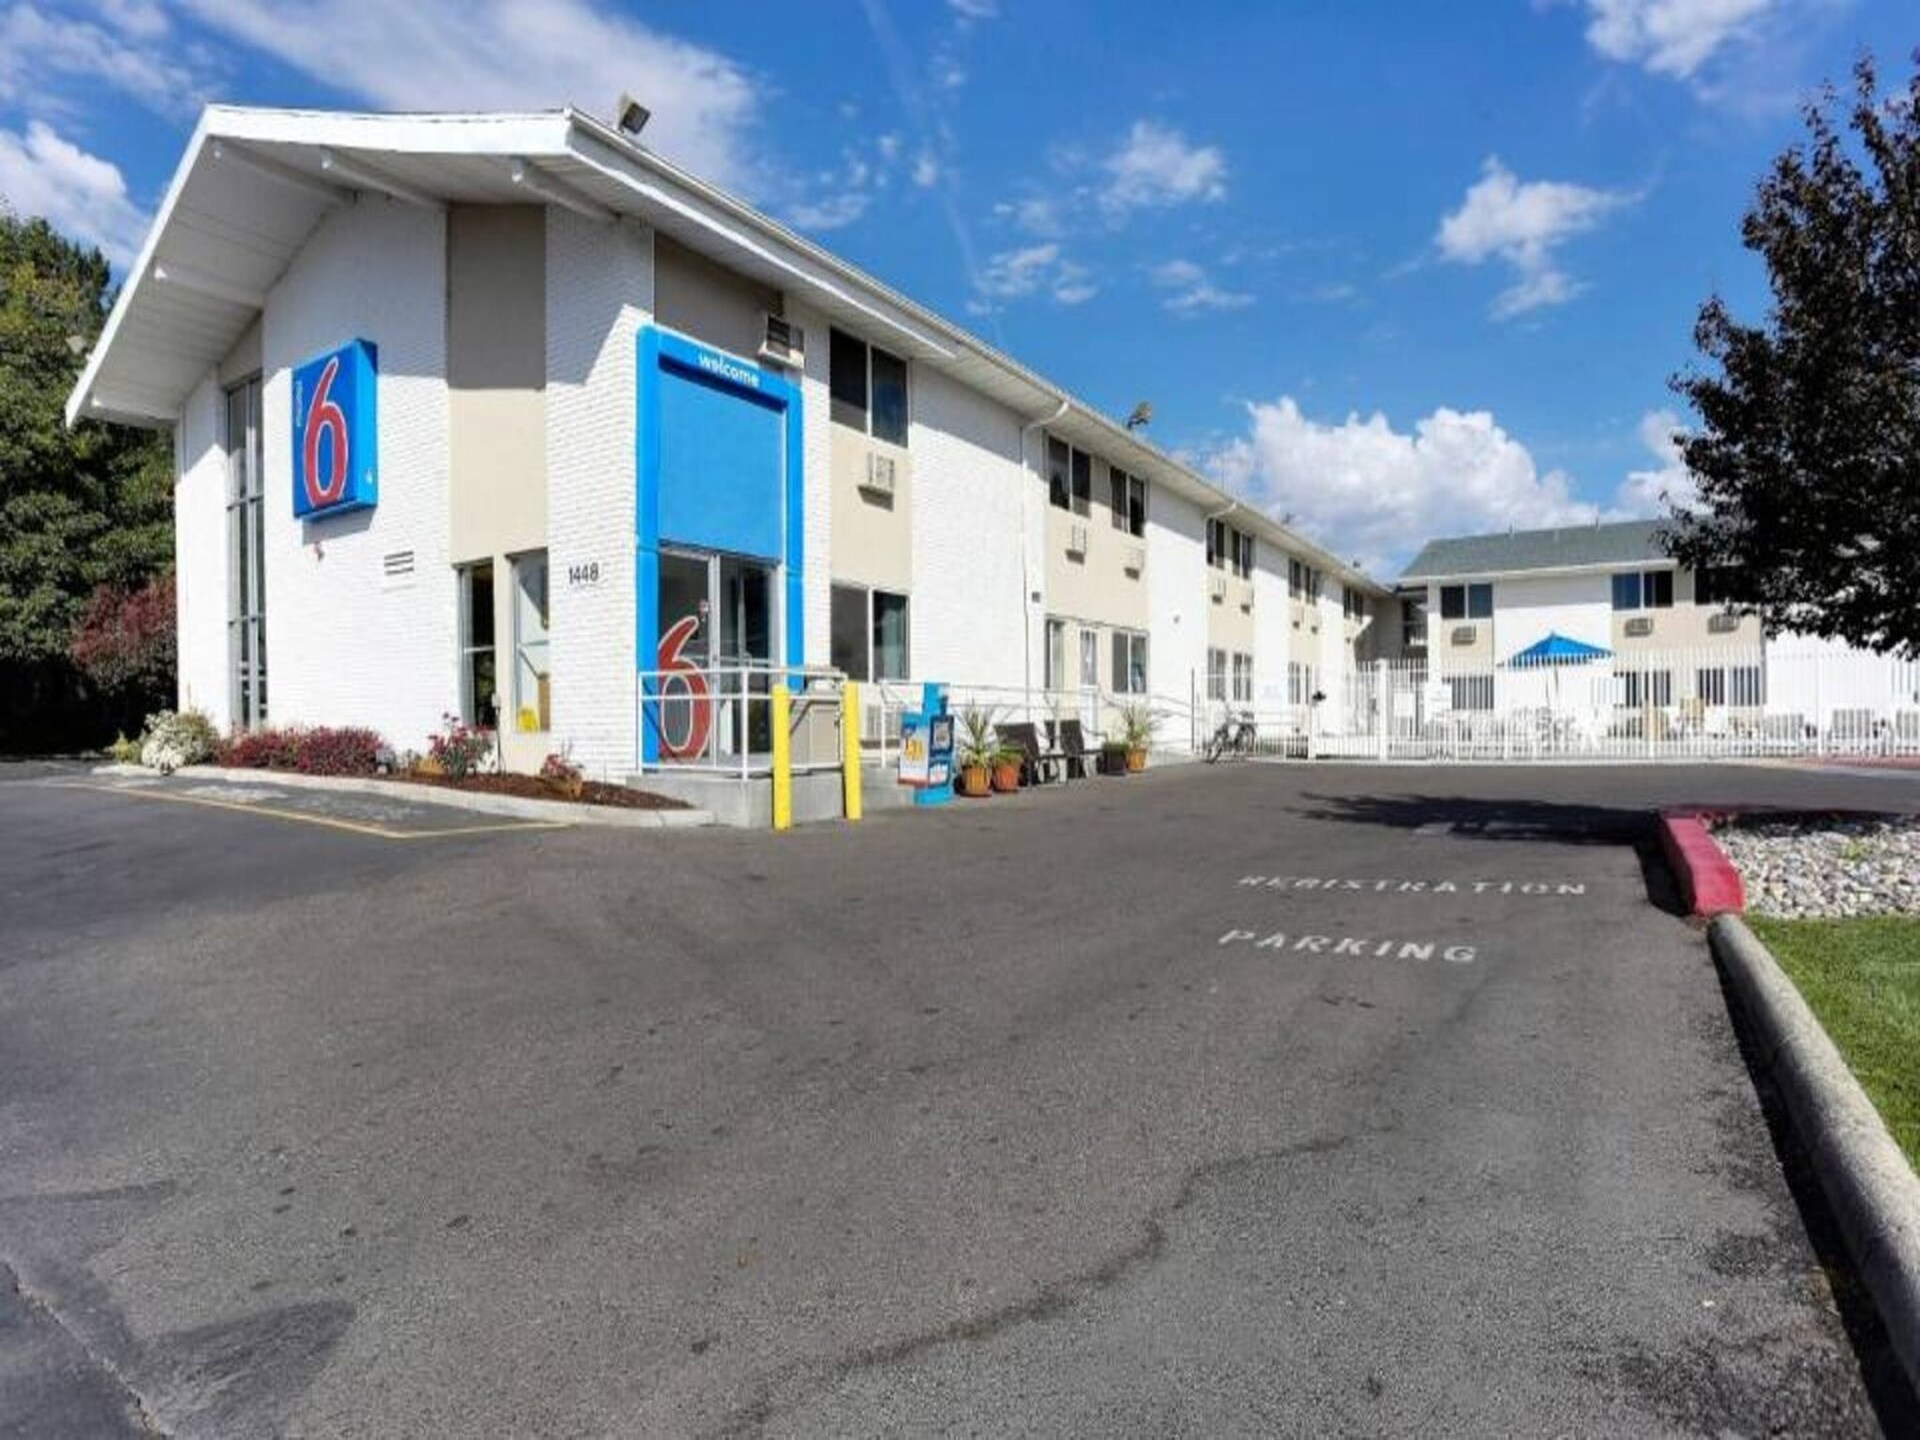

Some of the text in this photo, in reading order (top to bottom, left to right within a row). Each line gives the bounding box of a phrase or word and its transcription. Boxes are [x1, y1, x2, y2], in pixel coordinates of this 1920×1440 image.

[698, 353, 761, 387] welcome
[303, 355, 349, 508] 6
[568, 562, 599, 584] 1448
[657, 615, 711, 761] 6
[1218, 929, 1477, 963] PARKING
